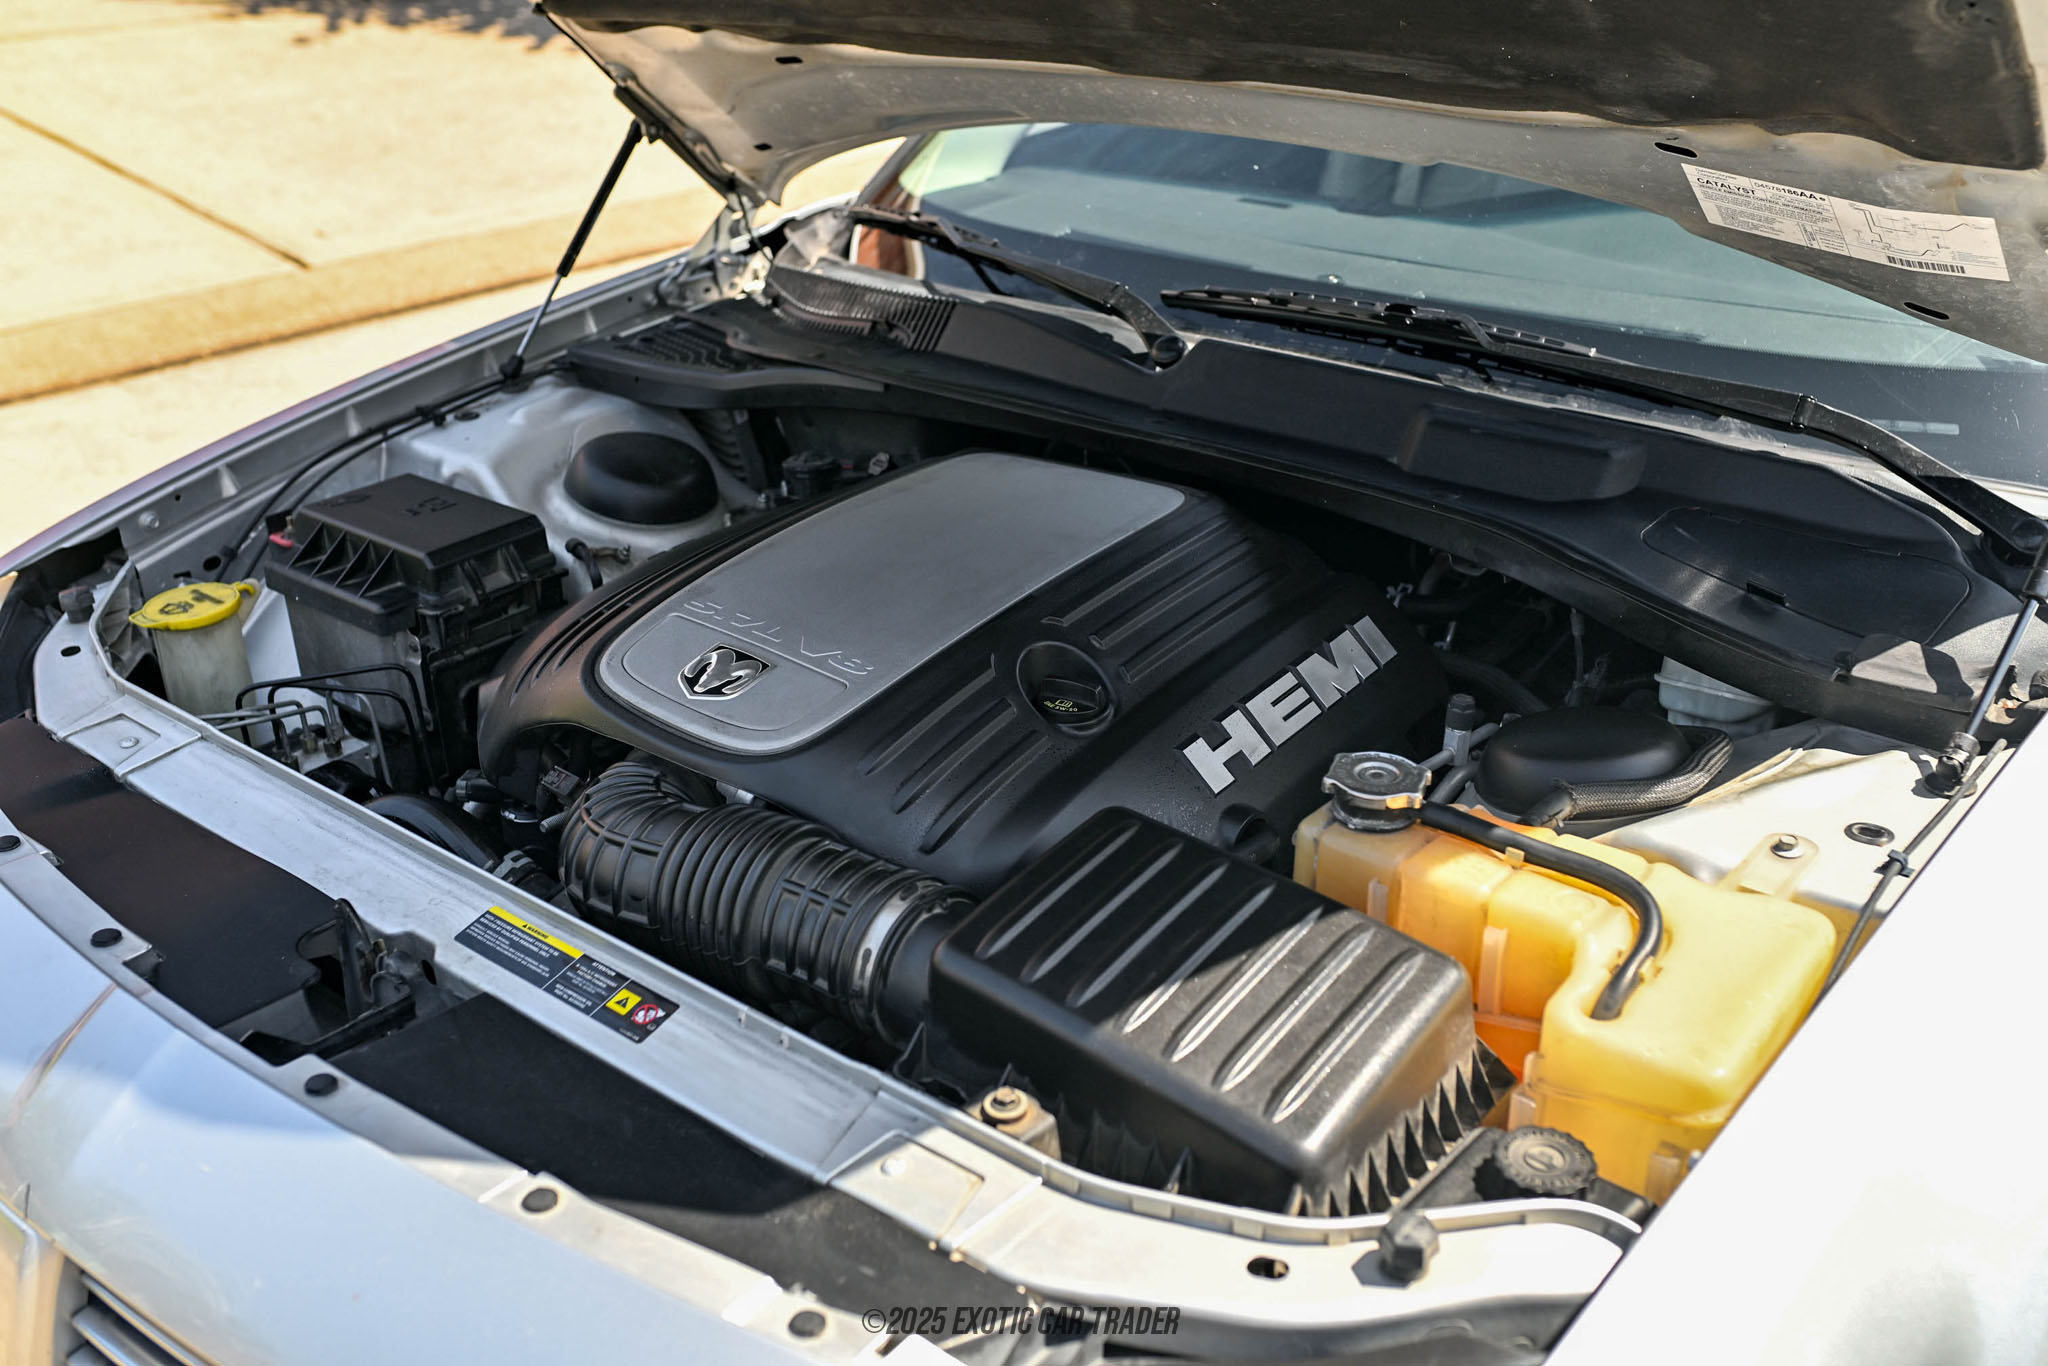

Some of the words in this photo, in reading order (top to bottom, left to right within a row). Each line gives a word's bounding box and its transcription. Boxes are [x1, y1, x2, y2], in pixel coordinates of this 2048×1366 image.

[1697, 177, 1755, 195] CATALYST
[1182, 615, 1398, 794] HEMI
[591, 962, 616, 976] ATTENTION
